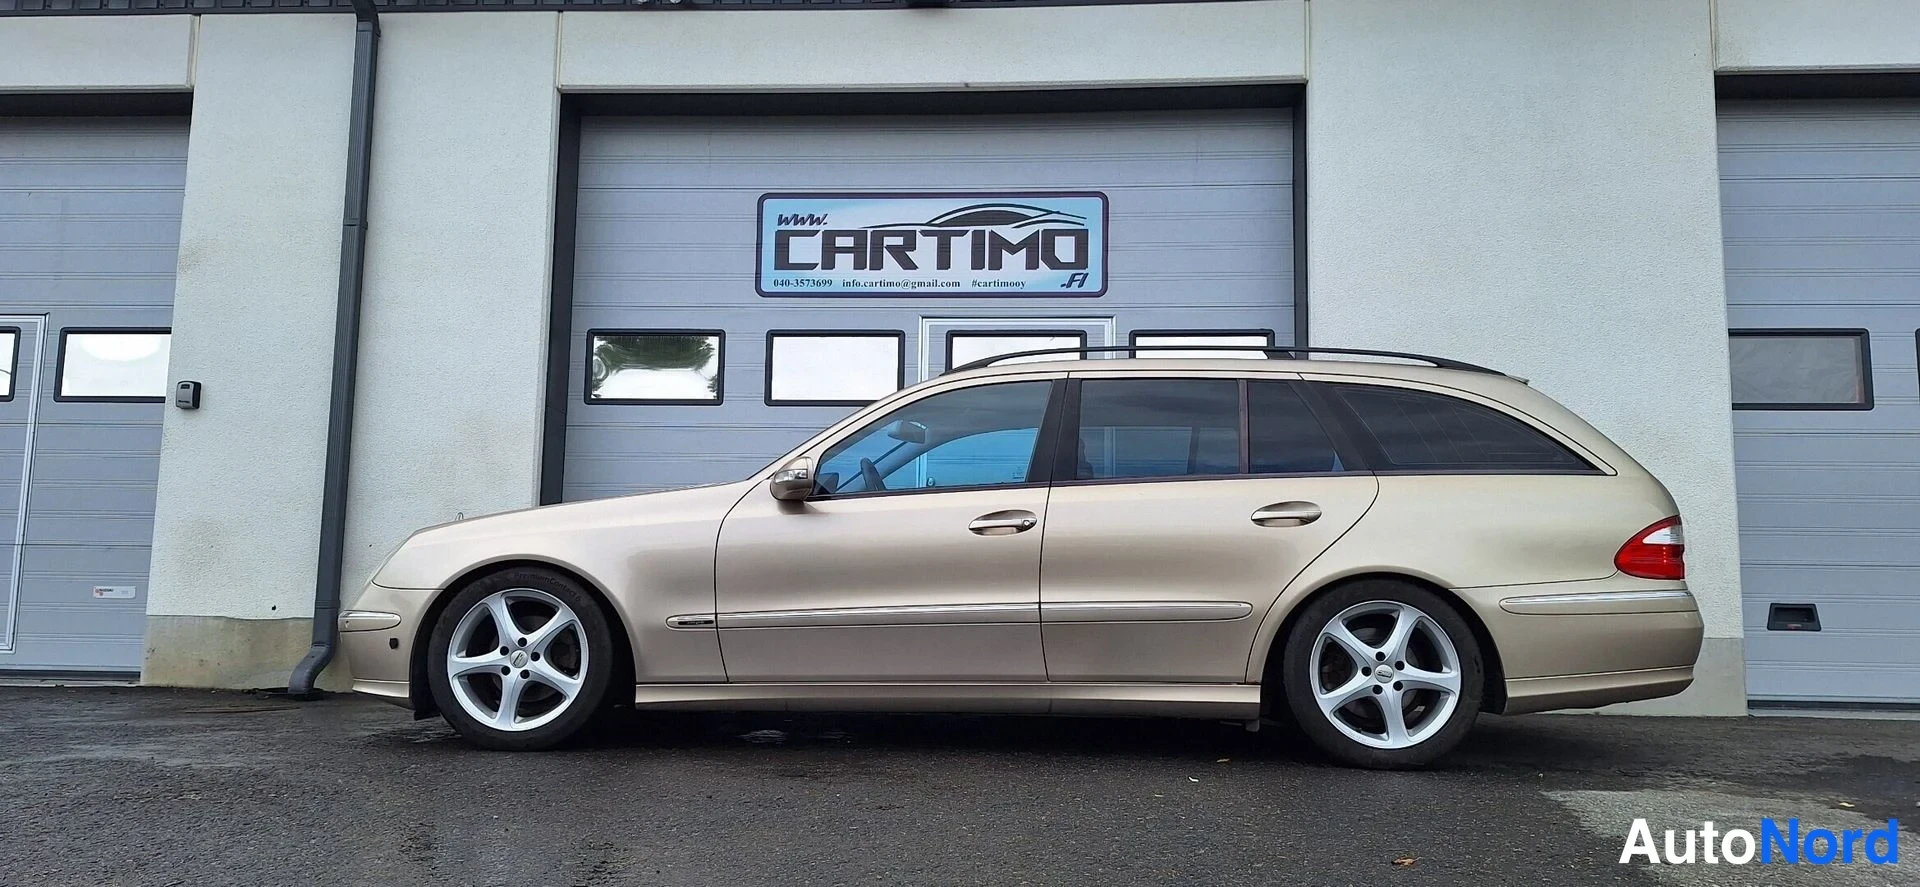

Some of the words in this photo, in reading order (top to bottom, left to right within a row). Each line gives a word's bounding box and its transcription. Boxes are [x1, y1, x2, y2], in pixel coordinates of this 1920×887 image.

[773, 228, 1089, 271] CARTIMO
[773, 278, 833, 288] 040-3573699
[842, 278, 961, 290] info.cartimo@gmail.com
[971, 278, 1027, 290] #cartimooy
